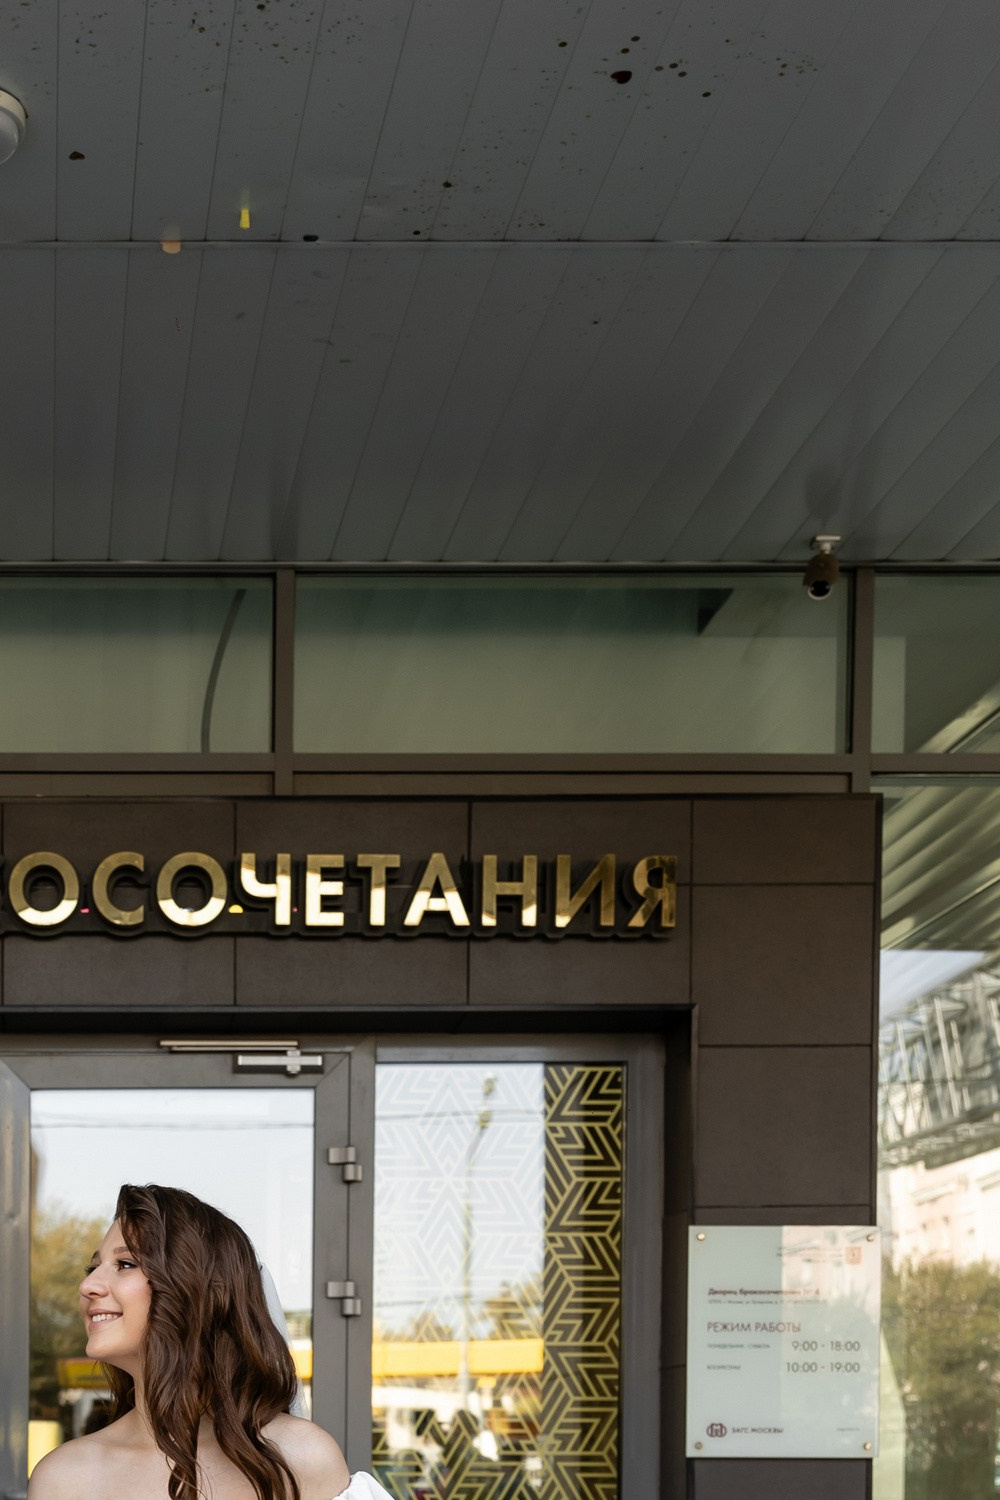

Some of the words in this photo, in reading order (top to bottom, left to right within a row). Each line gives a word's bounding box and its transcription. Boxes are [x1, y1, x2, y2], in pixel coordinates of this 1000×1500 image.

[706, 1321, 751, 1333] РЕЖИМ
[754, 1322, 802, 1333] РАБОТЫ
[791, 1340, 818, 1352] 9:00
[829, 1340, 861, 1352] 18:00
[785, 1361, 818, 1373] 10:00
[829, 1361, 861, 1373] 19:00
